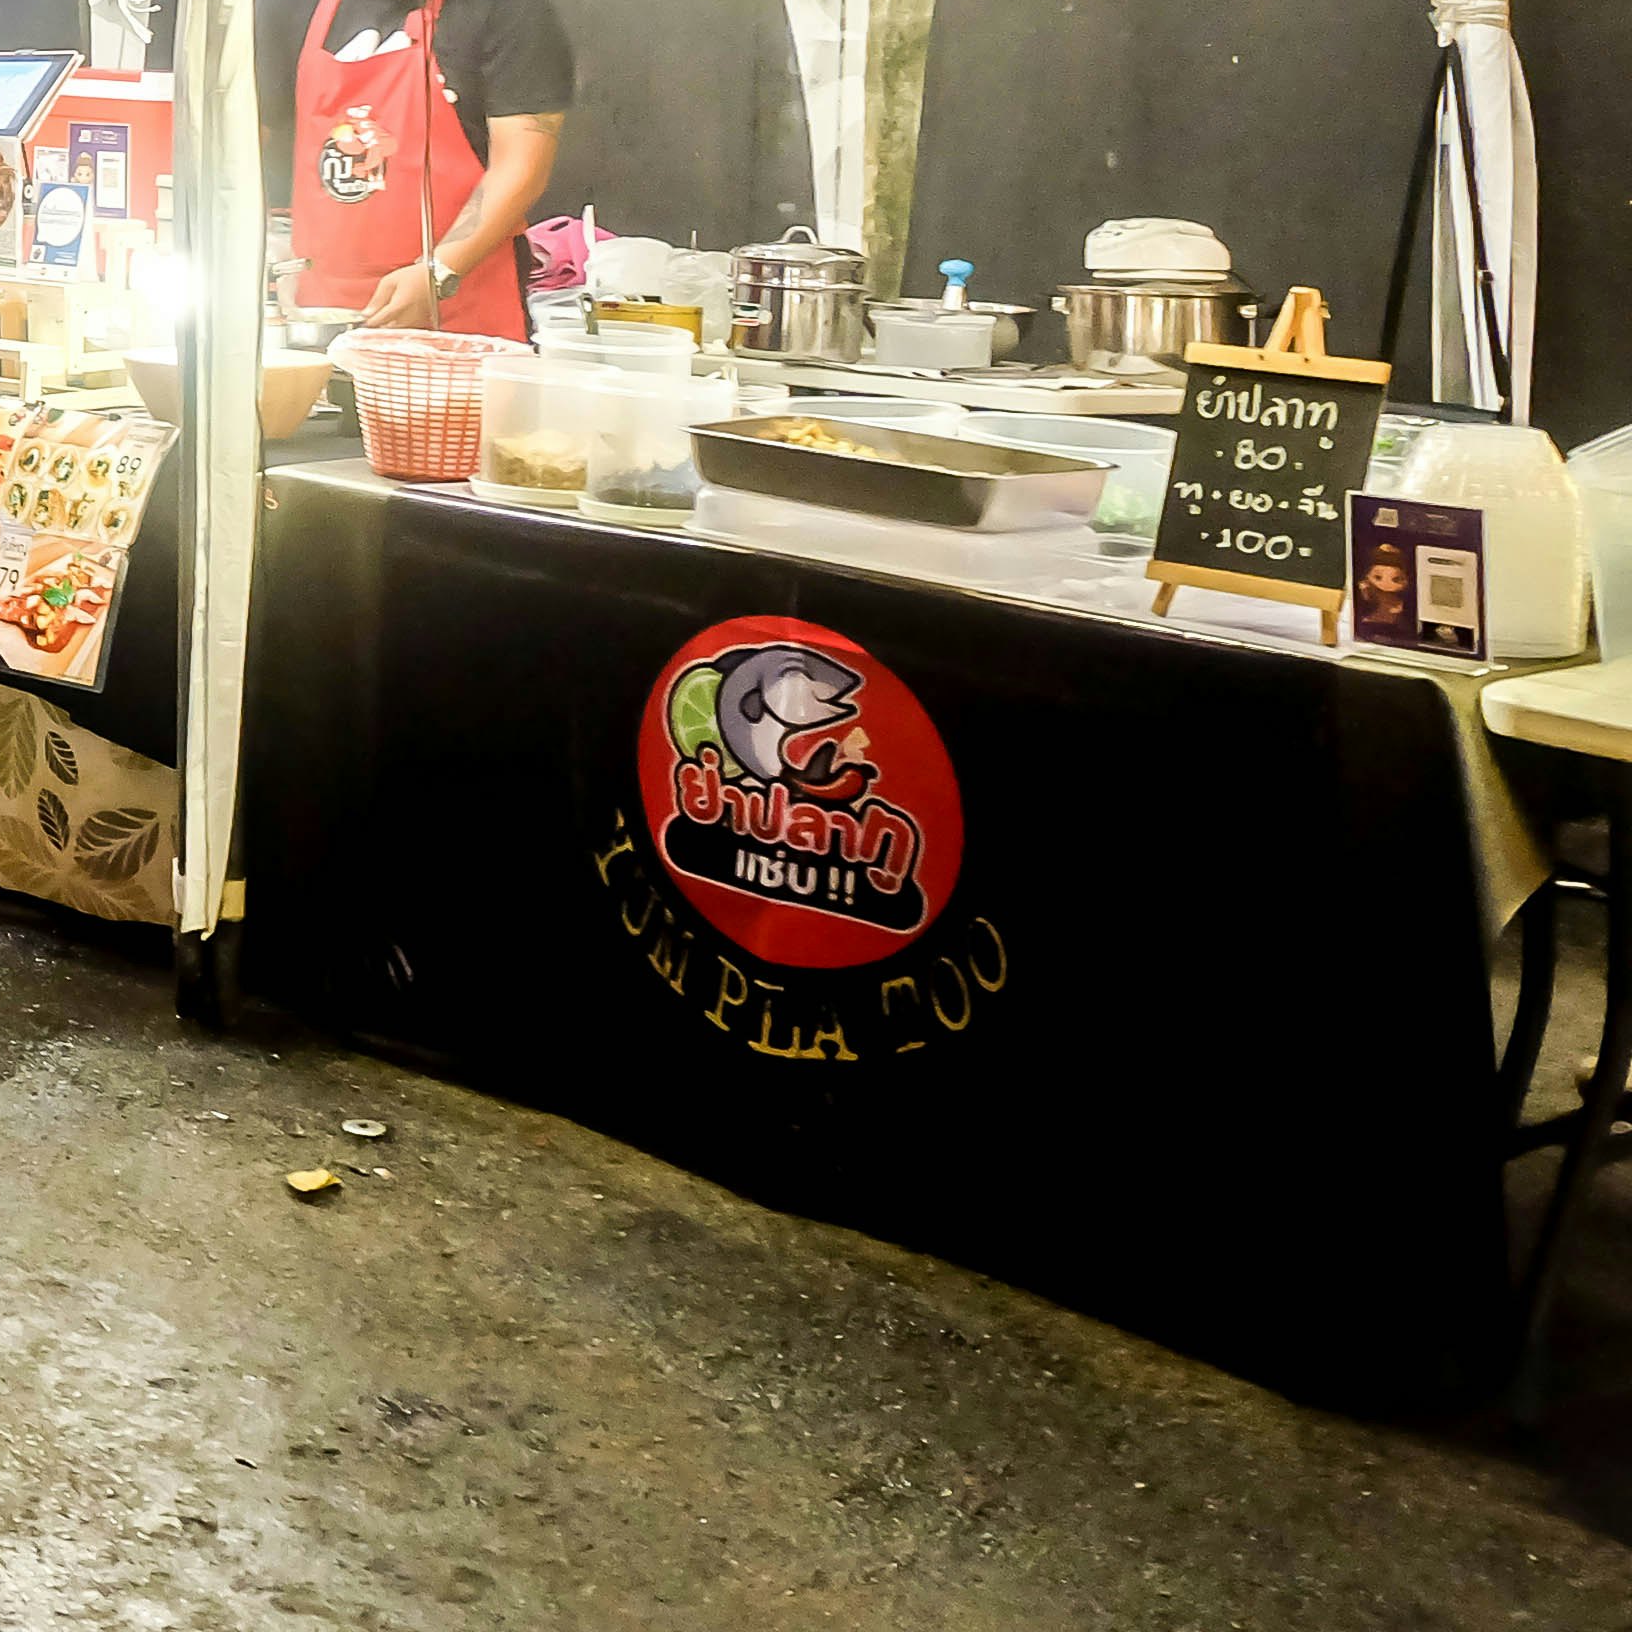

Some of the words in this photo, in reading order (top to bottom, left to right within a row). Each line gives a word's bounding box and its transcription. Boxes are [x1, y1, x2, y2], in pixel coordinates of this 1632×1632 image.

[1196, 375, 1339, 450] ยำปลาทู
[678, 747, 915, 895] ยำปลาทู
[736, 849, 817, 895] แซ่บ
[703, 954, 859, 1061] PLA
